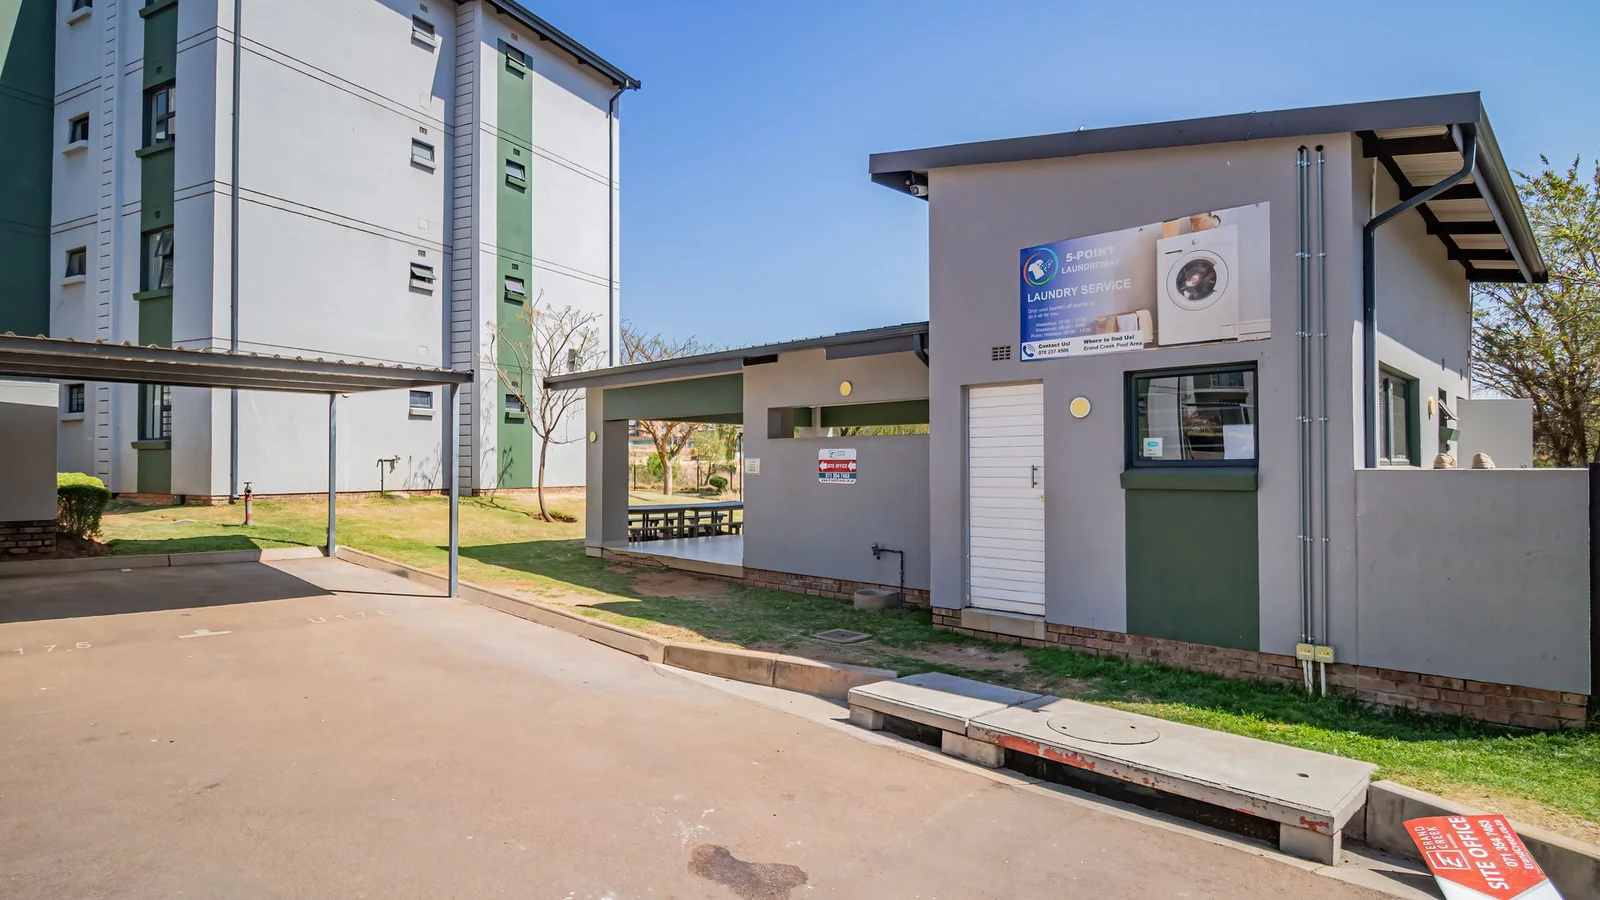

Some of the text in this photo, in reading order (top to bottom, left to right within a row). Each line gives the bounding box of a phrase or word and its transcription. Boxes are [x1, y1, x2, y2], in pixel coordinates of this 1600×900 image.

[1066, 244, 1116, 263] 5-POINT
[1061, 258, 1120, 275] LAUNDROMAT
[1027, 278, 1132, 303] LAUNDRY SERVICE
[1414, 825, 1437, 850] ERAND
[1426, 826, 1449, 850] CREEK
[1491, 837, 1508, 852] 354
[1447, 816, 1510, 891] SITE OFFICE
[1499, 851, 1519, 868] 071
